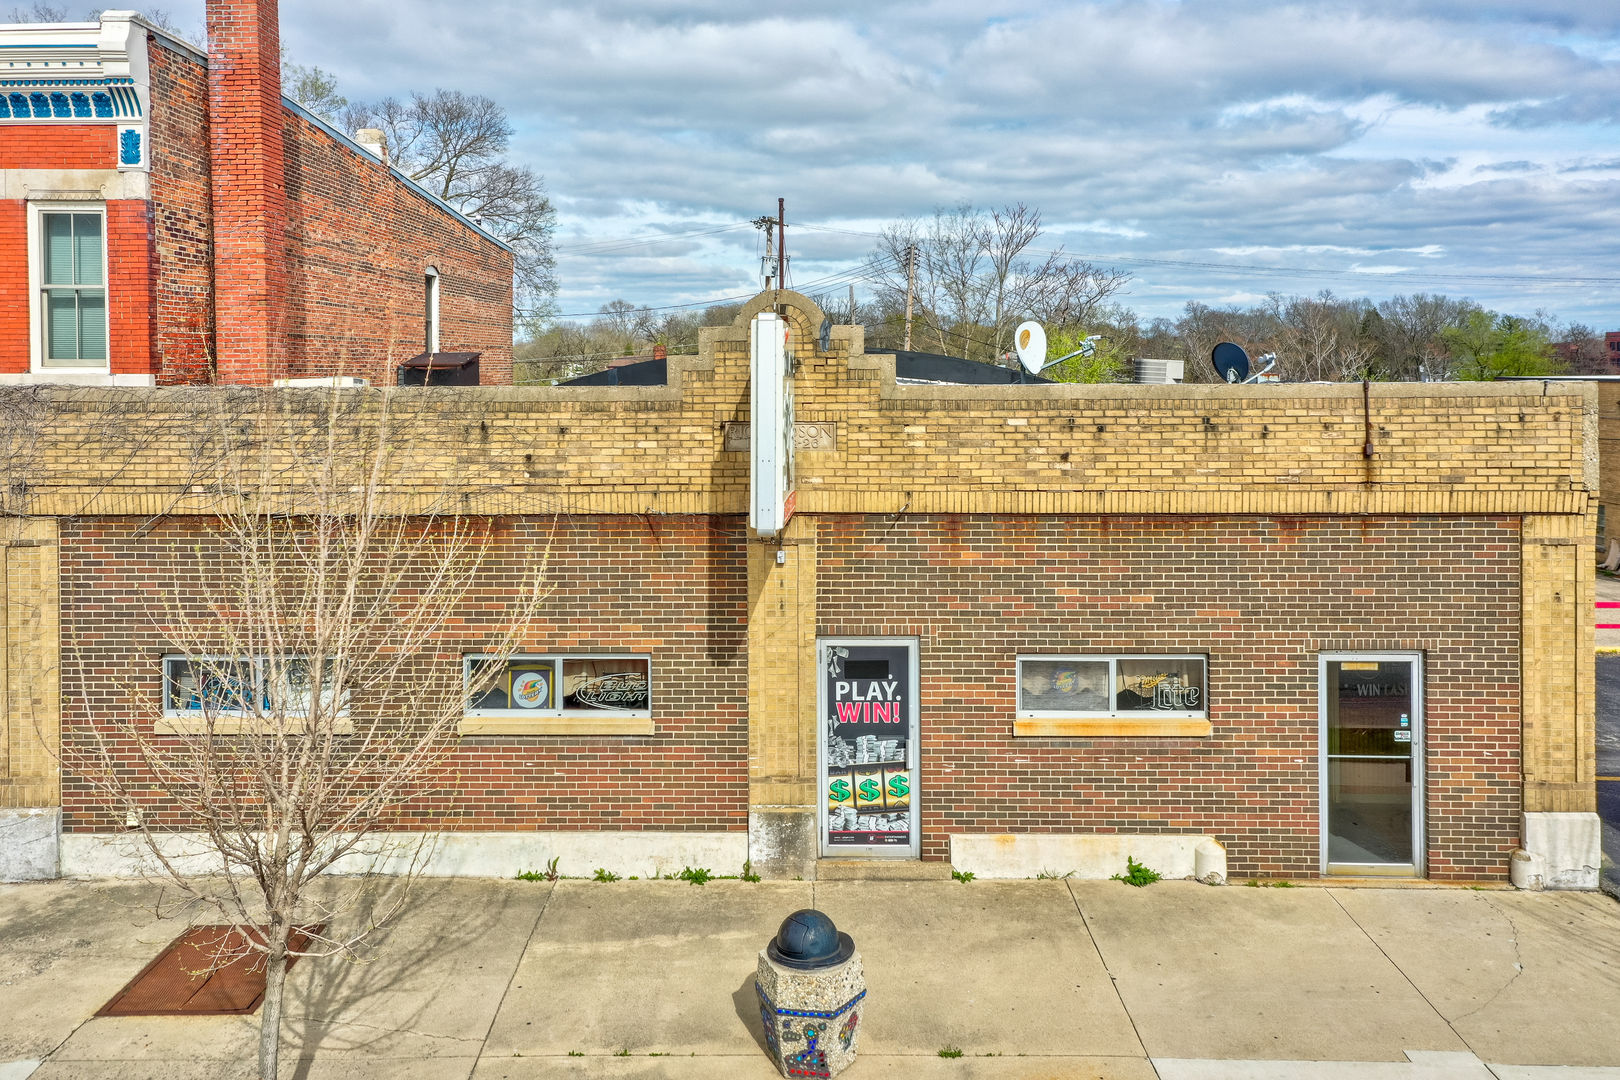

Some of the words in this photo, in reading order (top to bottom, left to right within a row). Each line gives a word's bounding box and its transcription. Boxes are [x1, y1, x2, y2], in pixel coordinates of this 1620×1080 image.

[835, 681, 902, 701] PLAY.
[1150, 681, 1200, 711] Lite
[1356, 683, 1381, 697] WIN
[835, 701, 900, 724] WIN!
